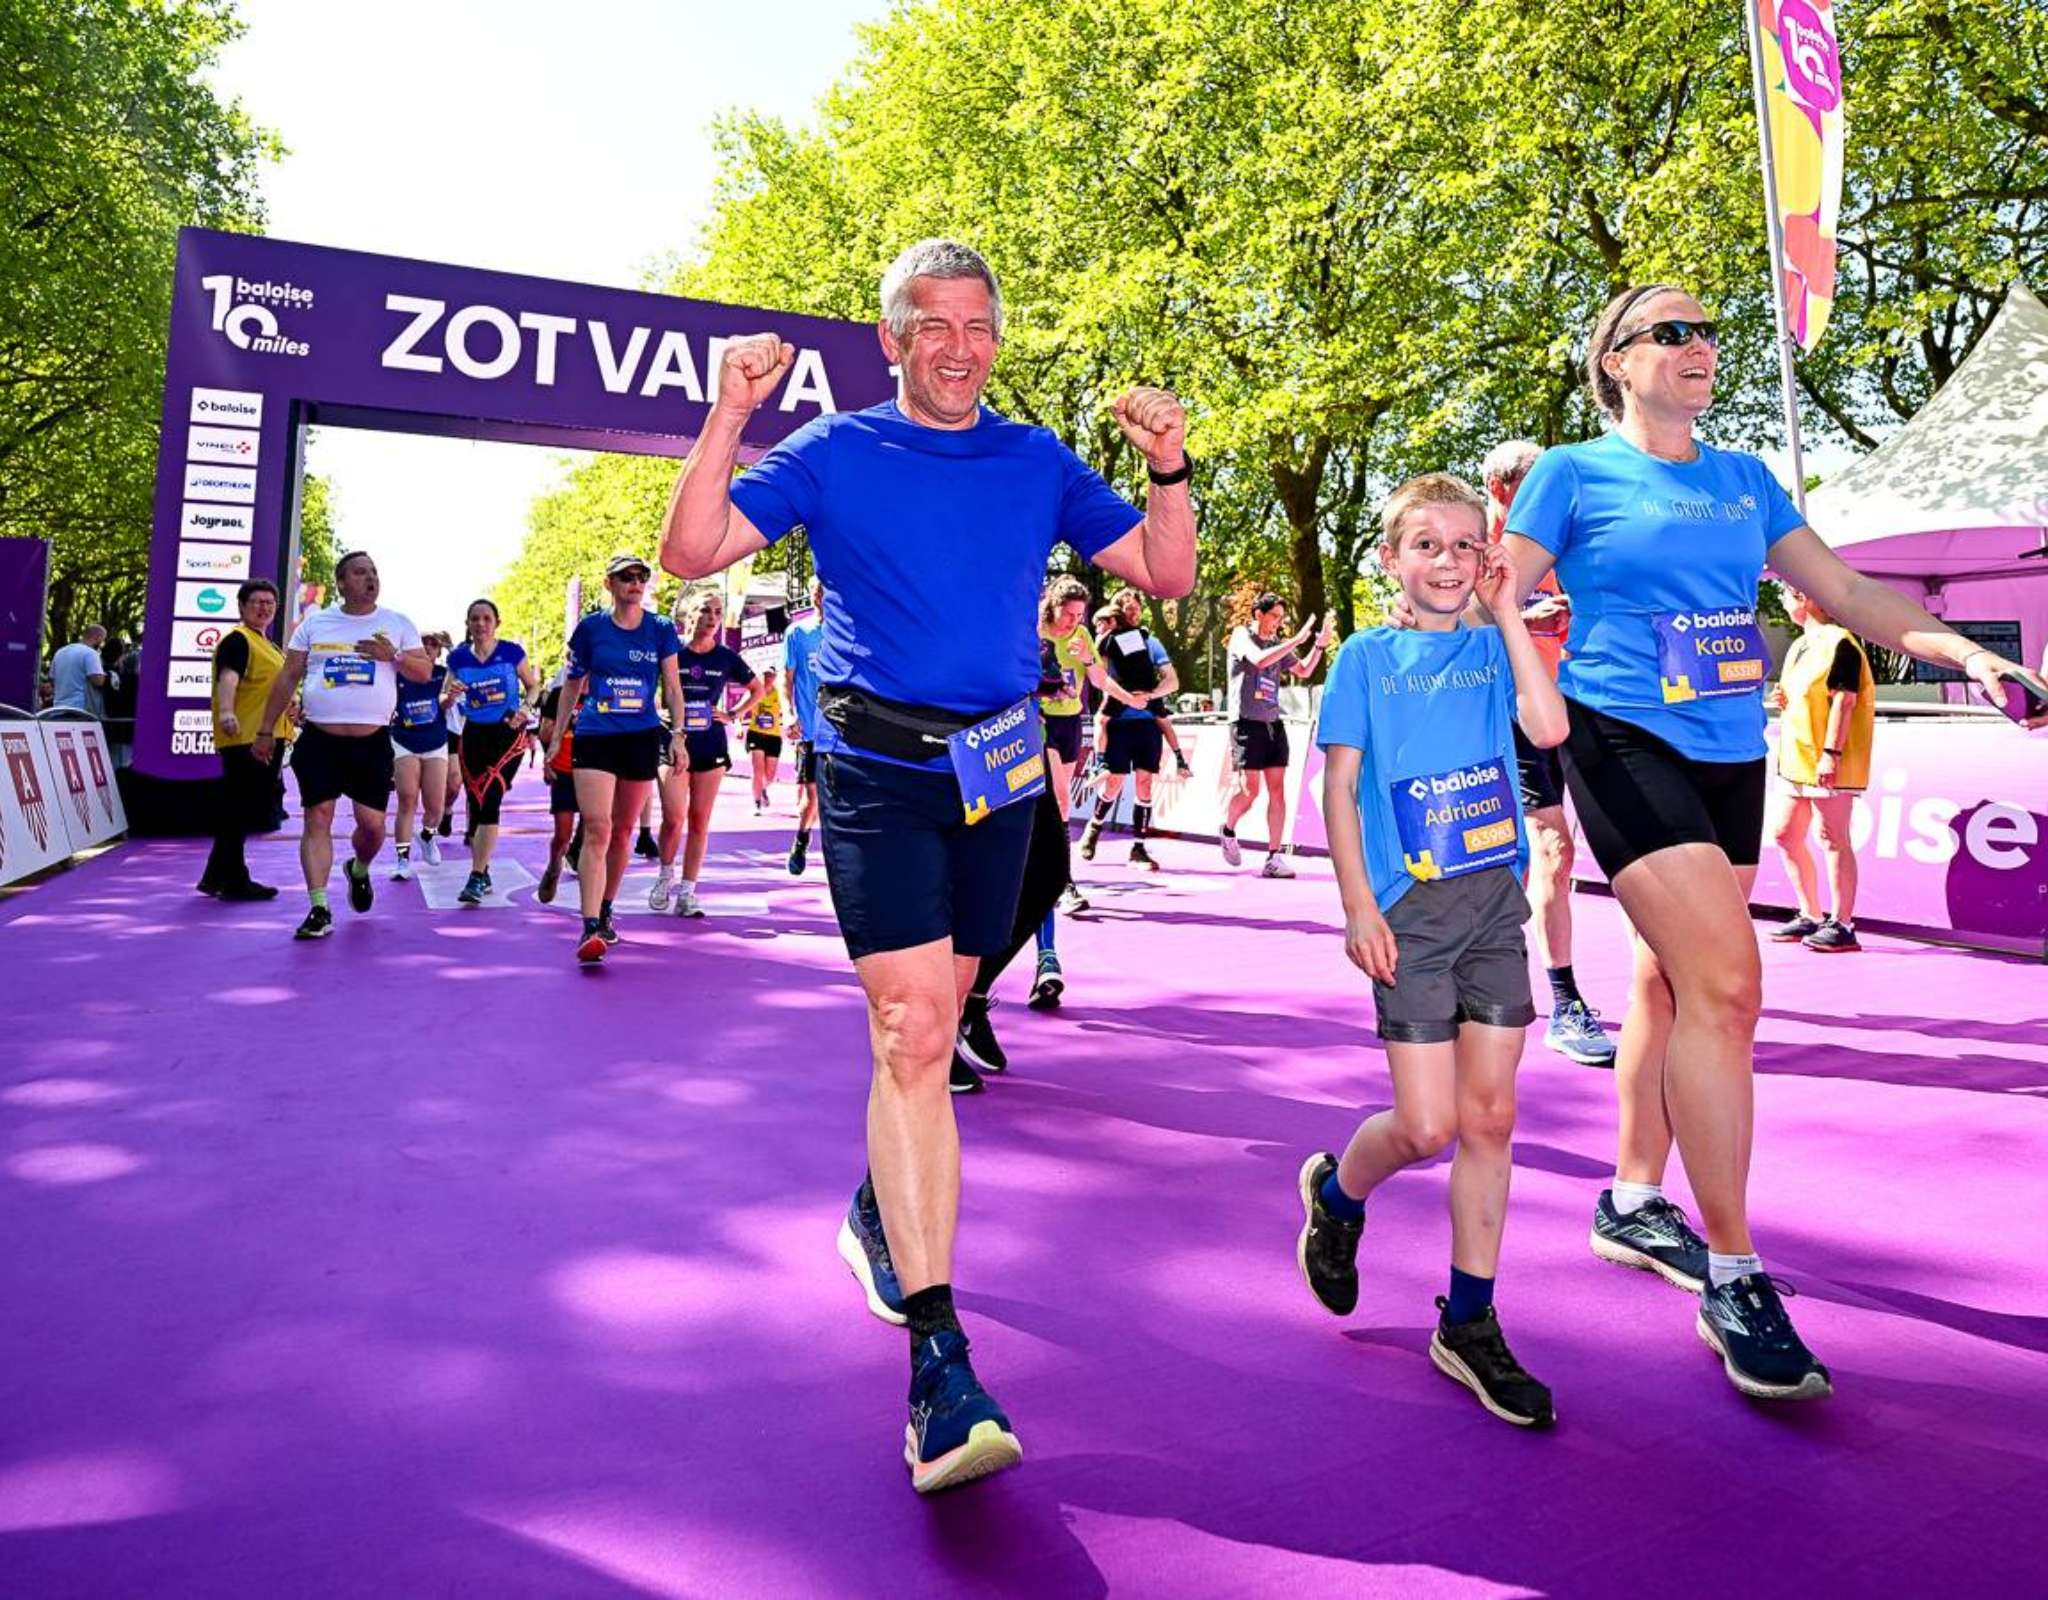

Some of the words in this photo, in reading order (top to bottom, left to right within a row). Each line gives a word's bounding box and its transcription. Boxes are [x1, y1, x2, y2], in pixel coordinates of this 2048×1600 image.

[236, 277, 314, 301] baloise
[252, 336, 310, 356] miles
[382, 294, 577, 385] ZOT
[211, 402, 257, 416] baloise
[1694, 608, 1754, 628] baloise
[1695, 635, 1745, 656] Kato
[980, 707, 1026, 742] baloise
[985, 739, 1026, 772] Marc
[1432, 765, 1500, 795] baloise
[1425, 795, 1501, 827] Adriaan
